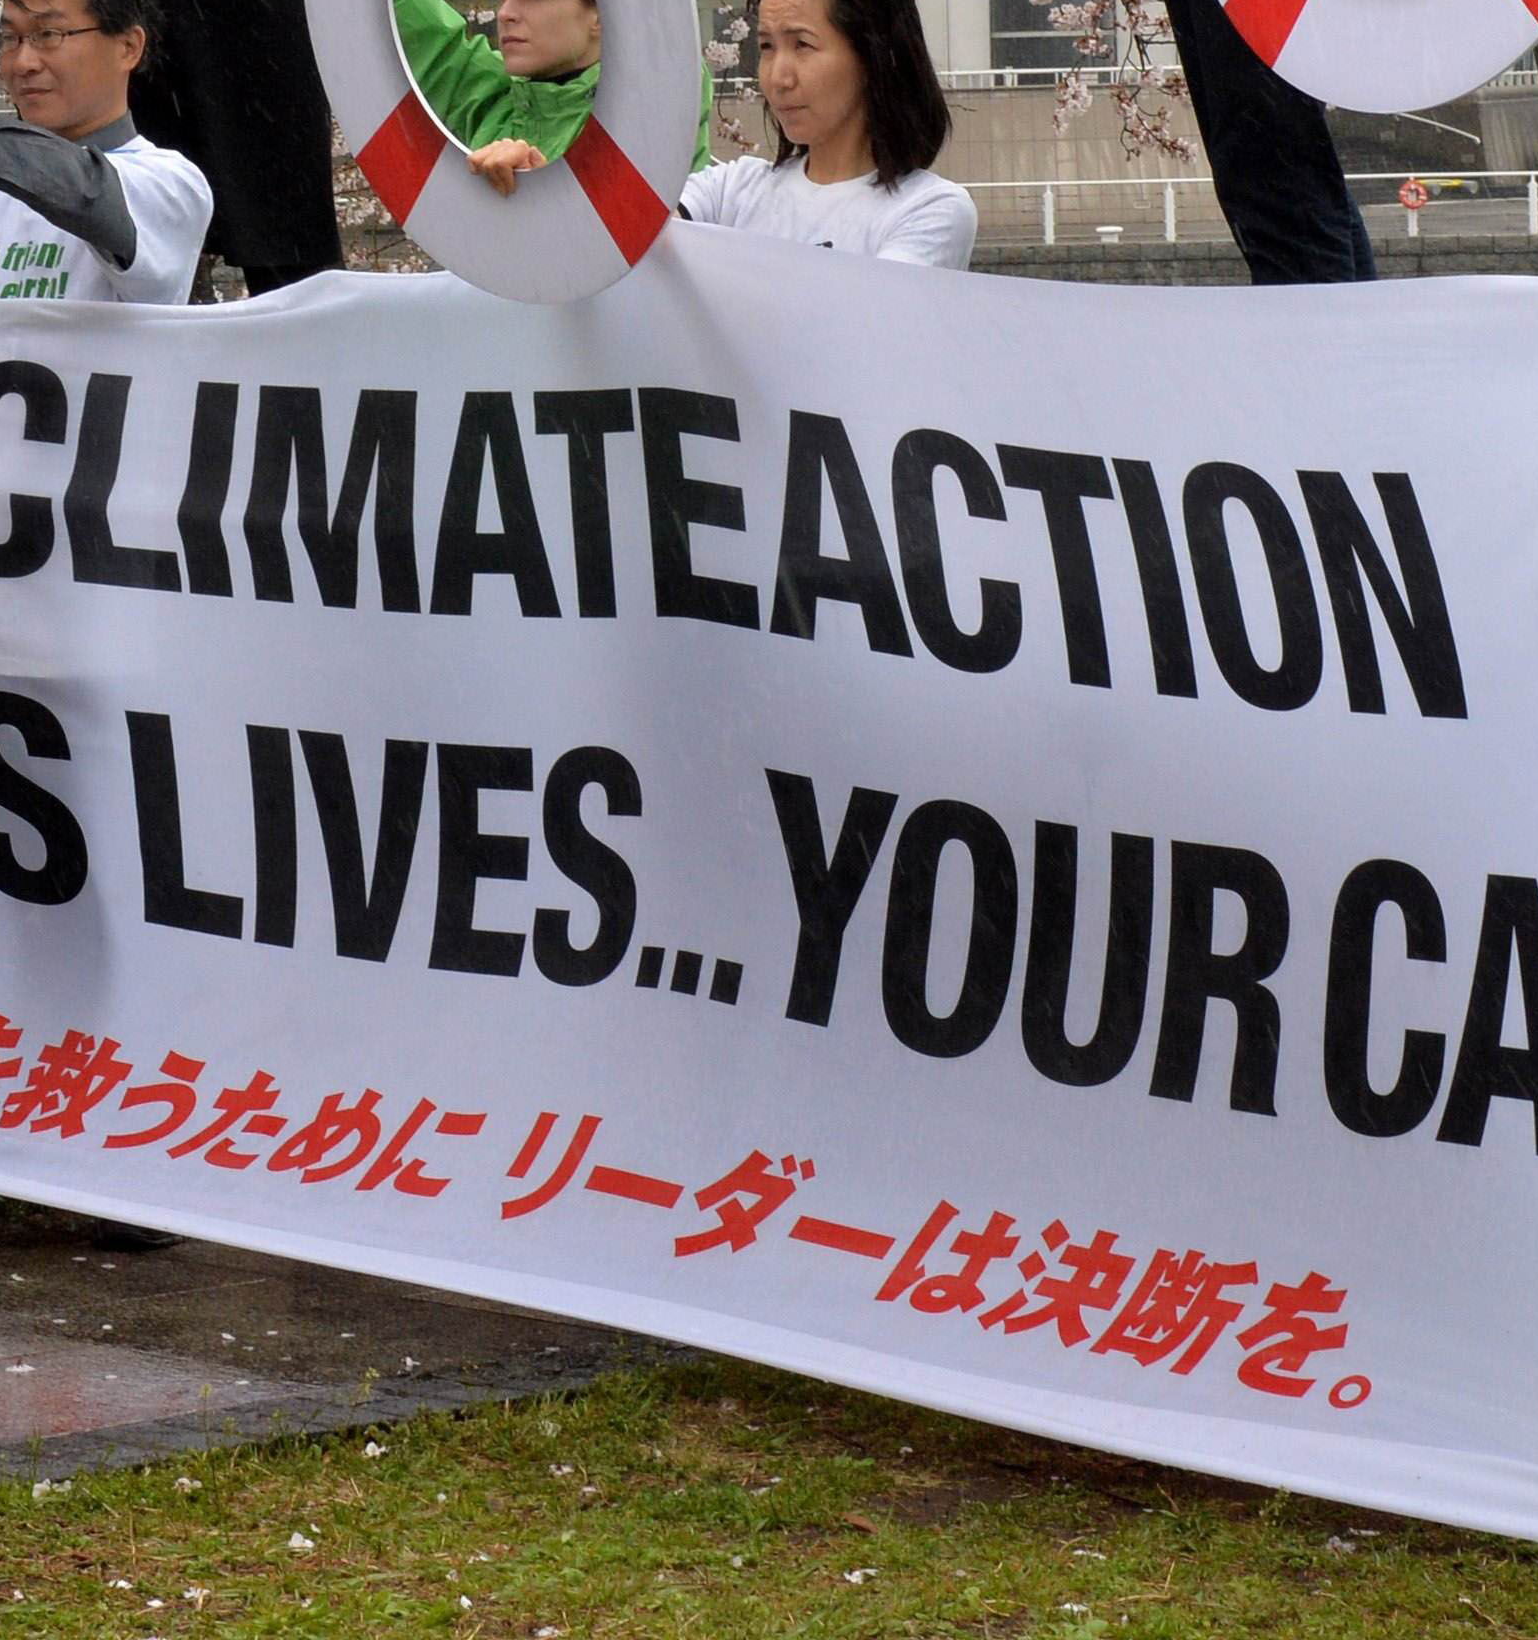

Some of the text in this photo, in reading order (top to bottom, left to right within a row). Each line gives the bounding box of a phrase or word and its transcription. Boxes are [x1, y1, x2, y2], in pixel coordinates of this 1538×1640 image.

[764, 767, 1290, 1117] YOUR
[501, 1111, 1373, 1410] リーダーは決断を。
